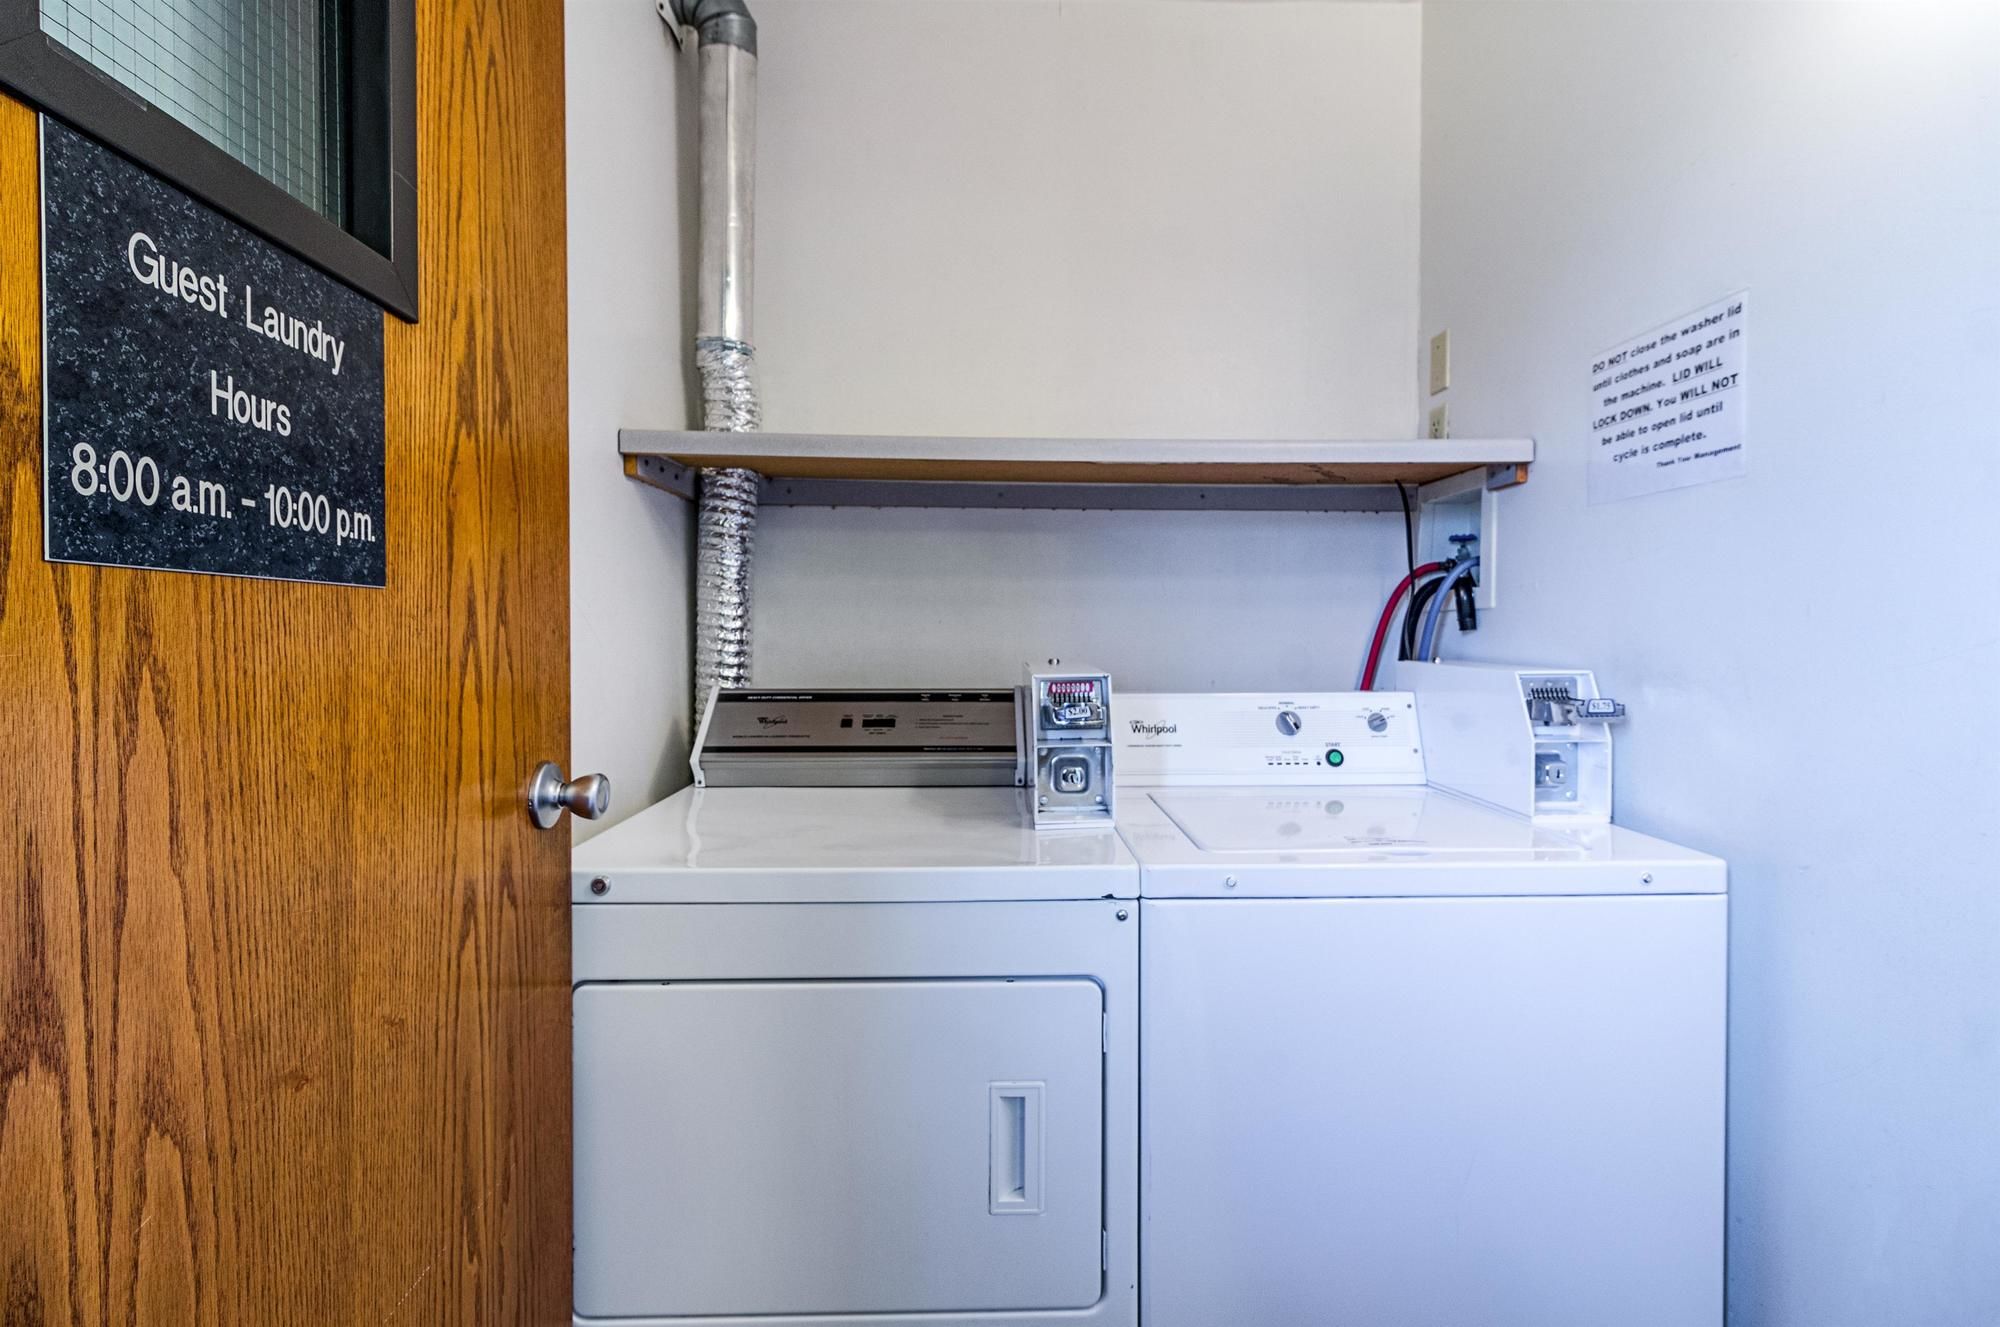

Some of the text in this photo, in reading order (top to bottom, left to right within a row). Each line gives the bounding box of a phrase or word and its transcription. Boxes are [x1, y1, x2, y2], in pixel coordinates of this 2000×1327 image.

[127, 231, 345, 375] Guest Laundry
[1592, 302, 1742, 374] DO NOT close the washer lid
[1593, 328, 1740, 392] until clothes and soap are in
[210, 369, 292, 437] Hours
[1592, 373, 1739, 430] LOCK DOWN. You WILL NOT
[1603, 356, 1723, 408] the machine. LID WILL
[1602, 400, 1723, 446] be able to open lid until
[1613, 432, 1706, 463] cycle is complete.
[71, 441, 160, 506] 8:00
[171, 474, 232, 520] a.m.
[264, 484, 331, 535] 10:00
[336, 505, 376, 546] p.m.
[1130, 724, 1177, 736] Whirlpool
